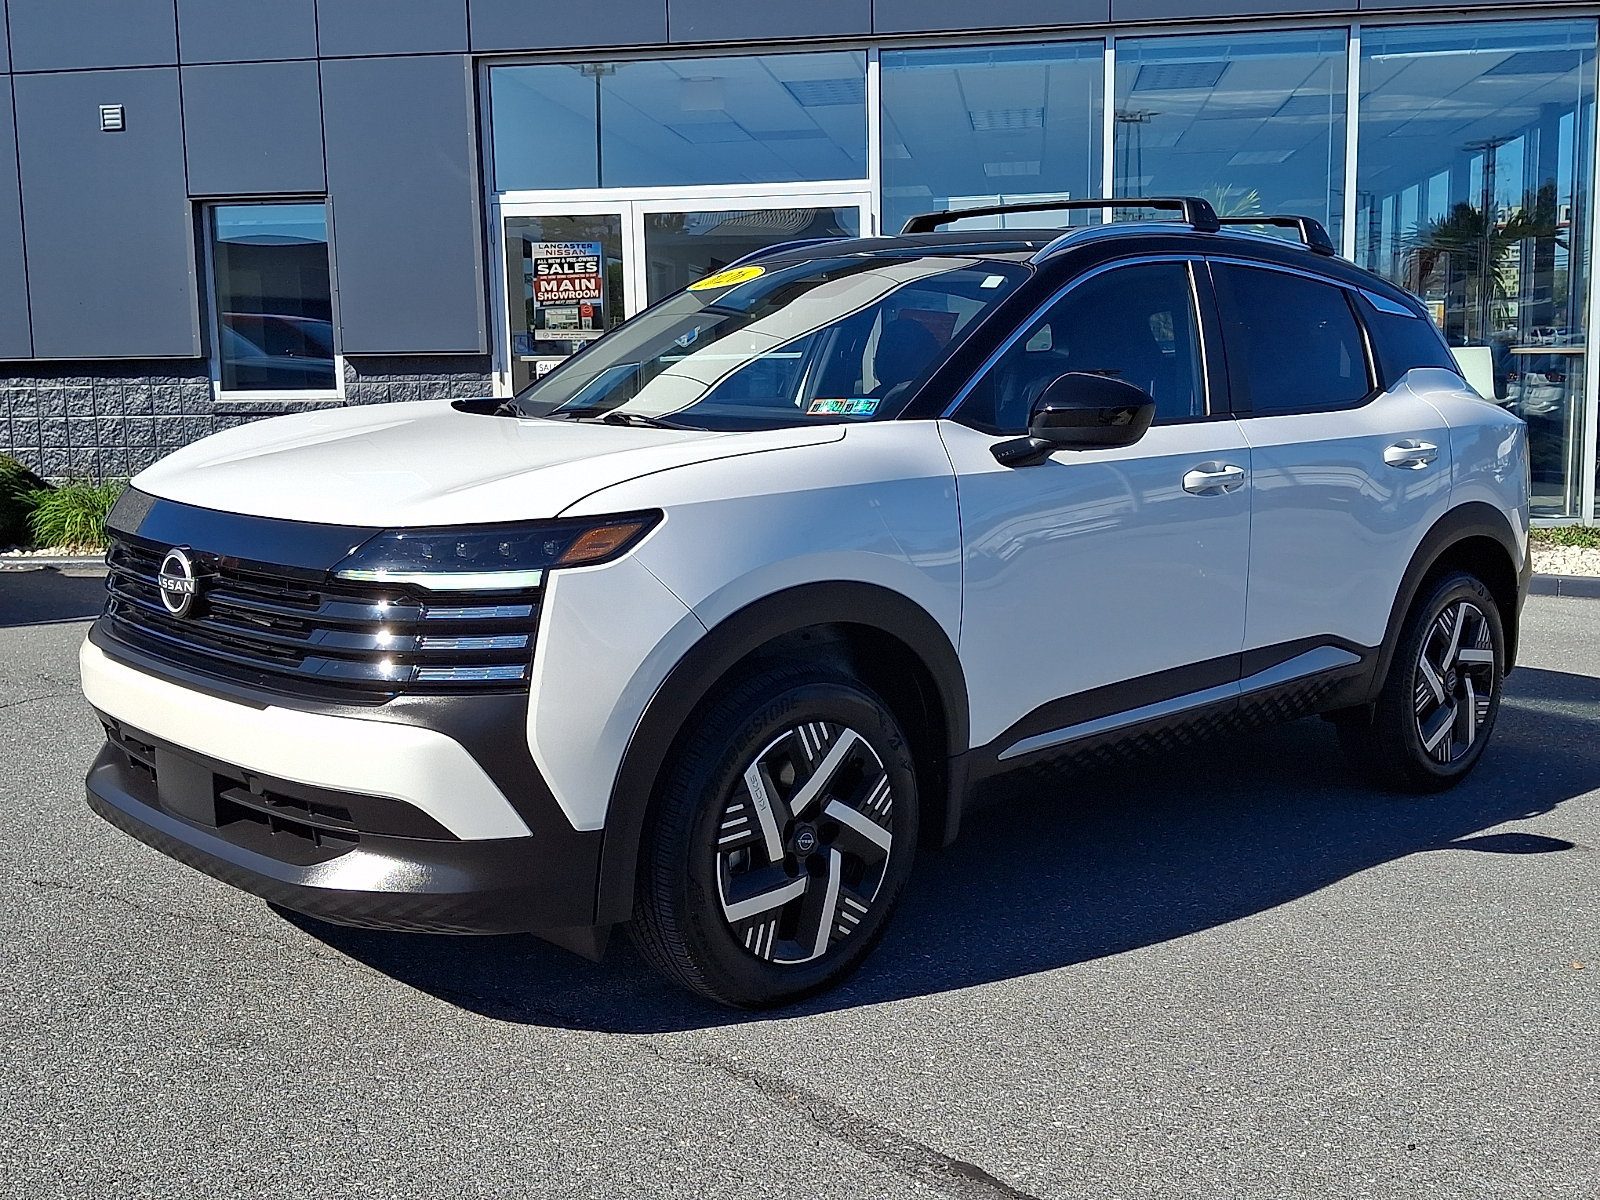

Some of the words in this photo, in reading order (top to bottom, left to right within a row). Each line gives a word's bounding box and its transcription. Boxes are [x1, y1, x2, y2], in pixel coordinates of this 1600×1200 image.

[537, 262, 598, 275] SALES
[540, 278, 596, 292] MAIN
[537, 289, 599, 301] SHOWROOM
[750, 774, 767, 811] KICKS
